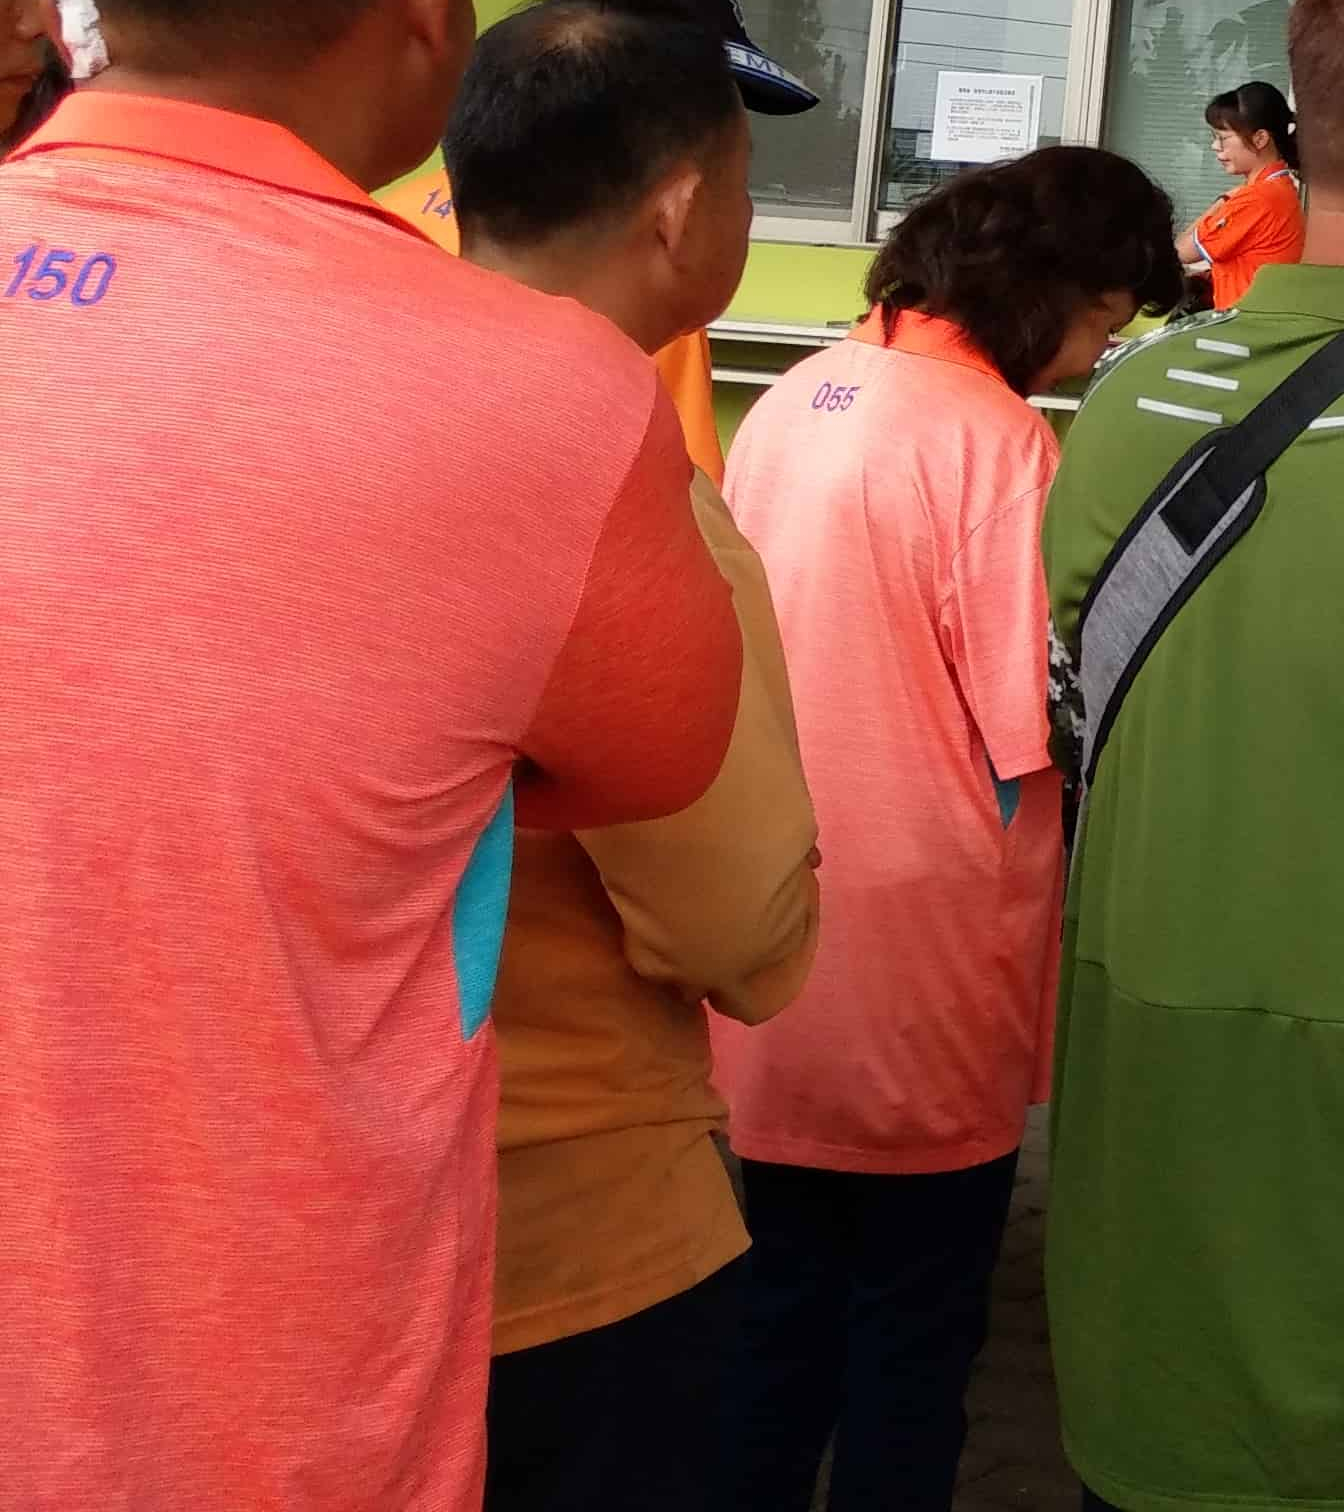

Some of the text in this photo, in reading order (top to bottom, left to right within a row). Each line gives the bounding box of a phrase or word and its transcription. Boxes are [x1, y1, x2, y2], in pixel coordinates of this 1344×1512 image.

[421, 187, 453, 219] 14
[4, 242, 118, 307] 150
[811, 381, 862, 413] 055
